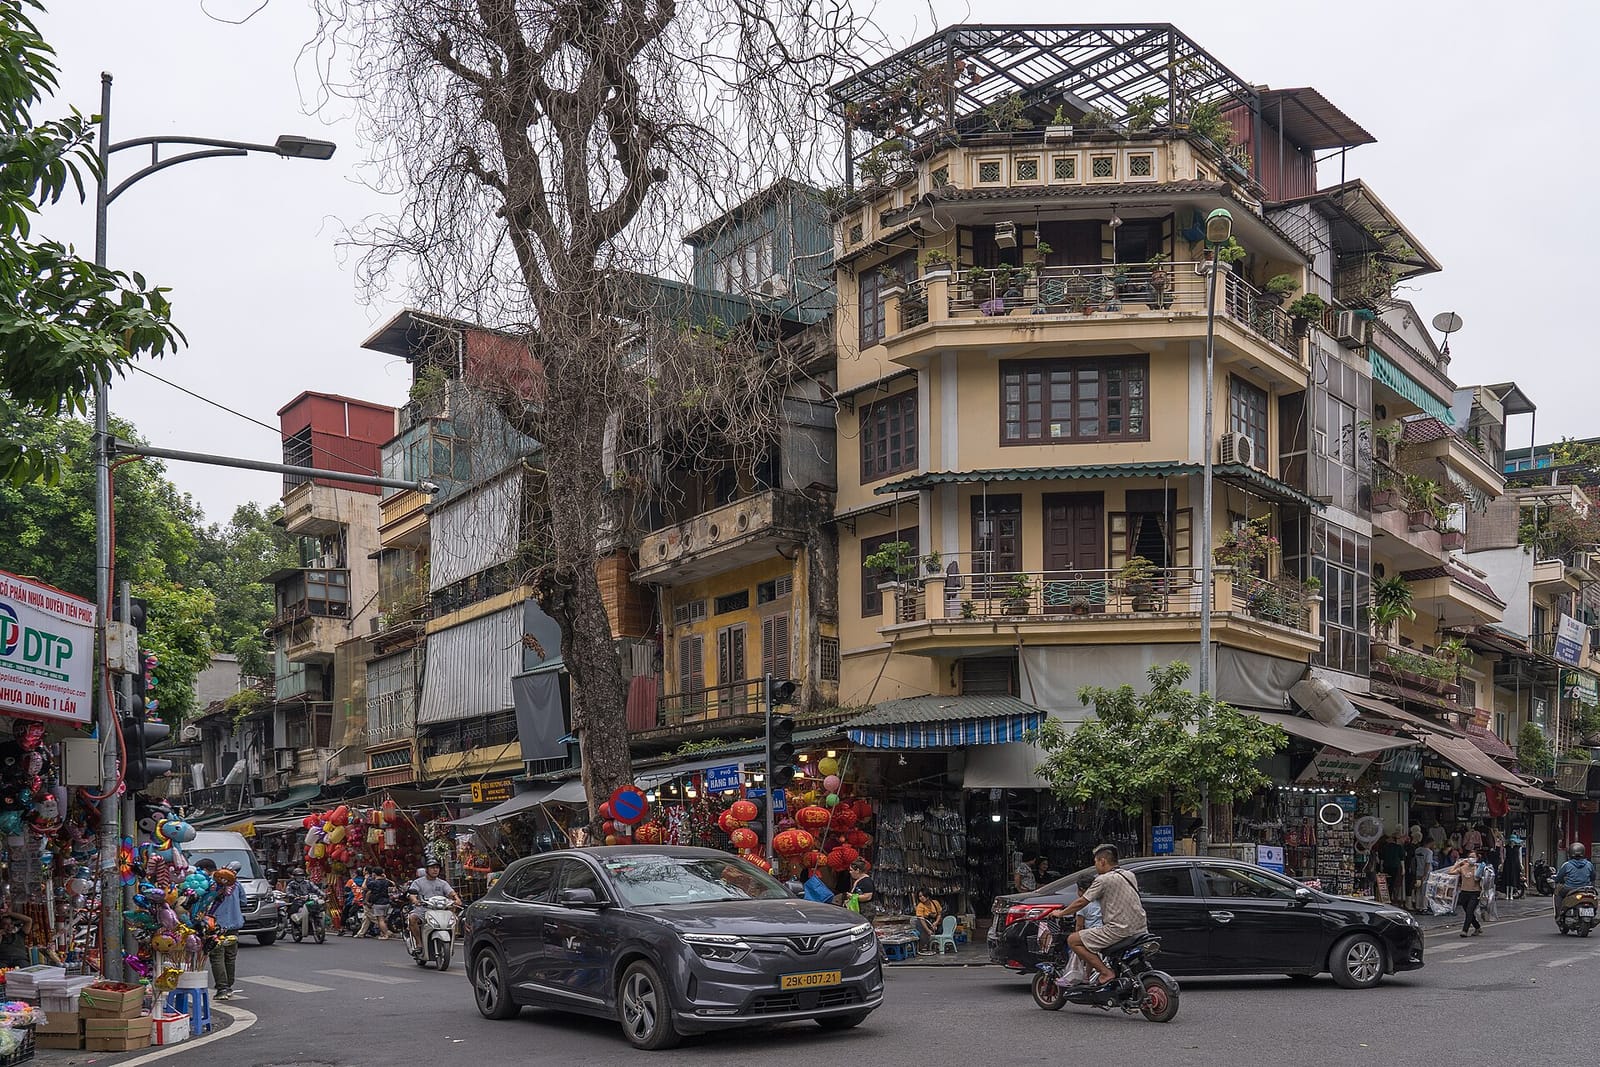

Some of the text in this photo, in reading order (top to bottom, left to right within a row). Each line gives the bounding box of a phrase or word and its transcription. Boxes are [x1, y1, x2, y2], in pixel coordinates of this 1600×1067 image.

[23, 626, 73, 669] DTP
[52, 699, 57, 710] 1
[710, 776, 727, 789] HÀNG
[786, 973, 836, 987] 29K-007.21
